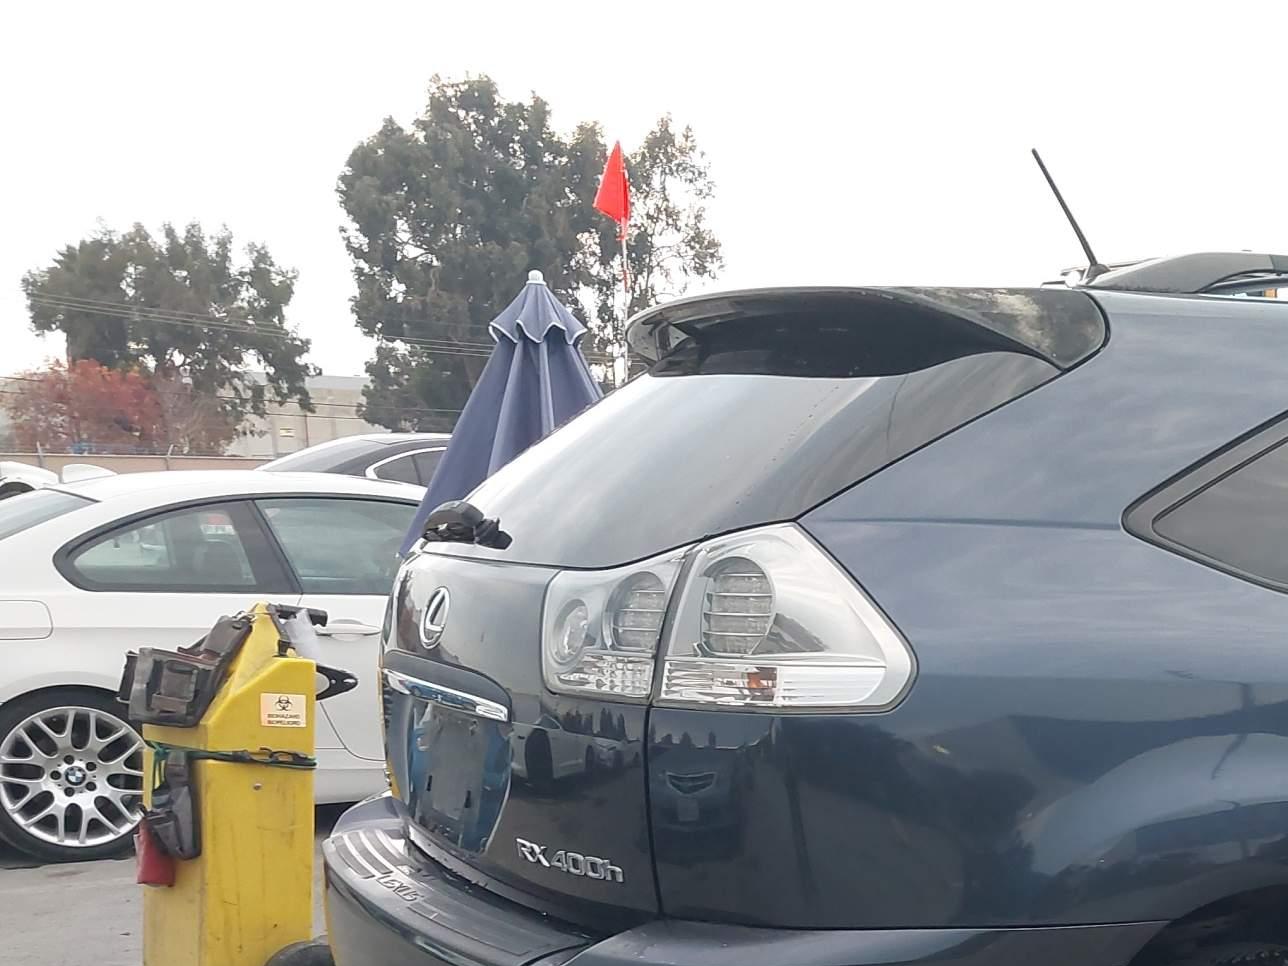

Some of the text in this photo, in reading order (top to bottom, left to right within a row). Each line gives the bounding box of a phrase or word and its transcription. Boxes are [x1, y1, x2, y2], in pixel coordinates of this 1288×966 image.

[516, 837, 624, 883] RX 400h
[375, 874, 425, 902] LEXUS
